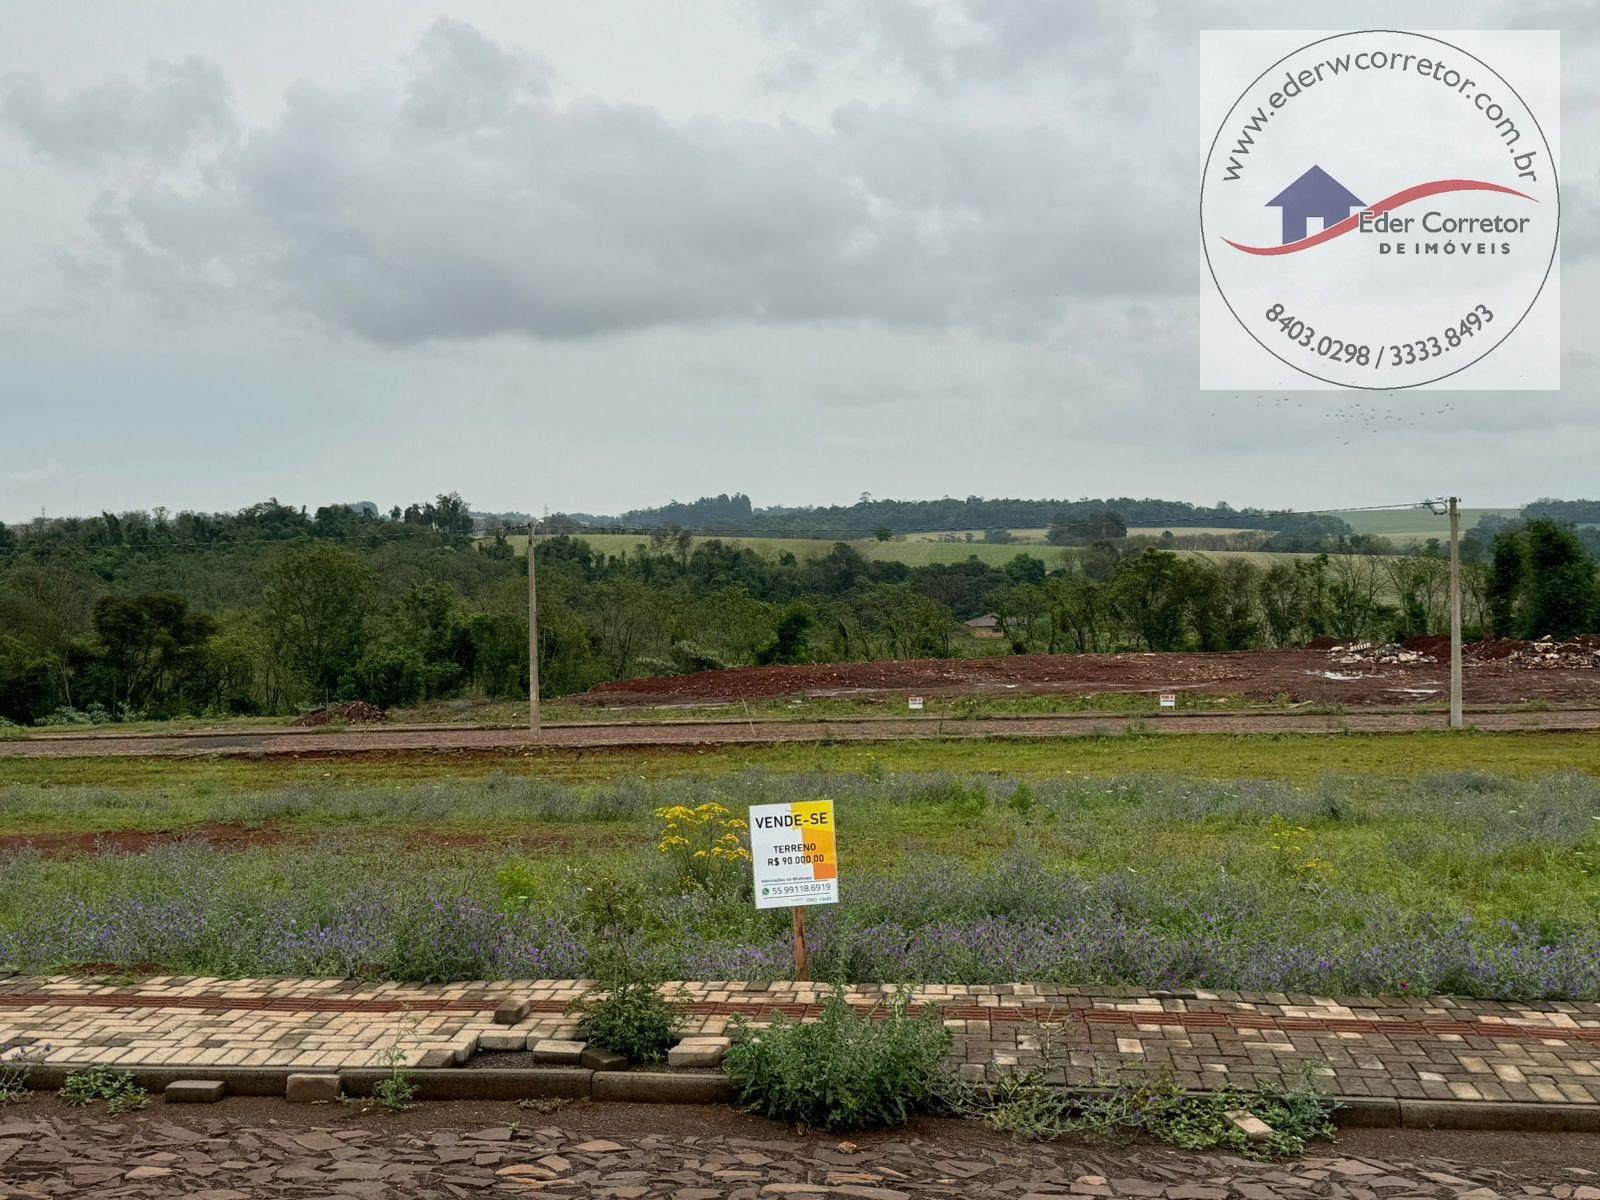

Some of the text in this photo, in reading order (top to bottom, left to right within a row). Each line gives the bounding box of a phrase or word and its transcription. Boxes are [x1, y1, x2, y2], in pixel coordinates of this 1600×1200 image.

[755, 812, 828, 829] VENDE-SE
[773, 843, 816, 853] TERRENO
[767, 857, 780, 866] R$
[772, 883, 831, 895] 55 99118.6919
